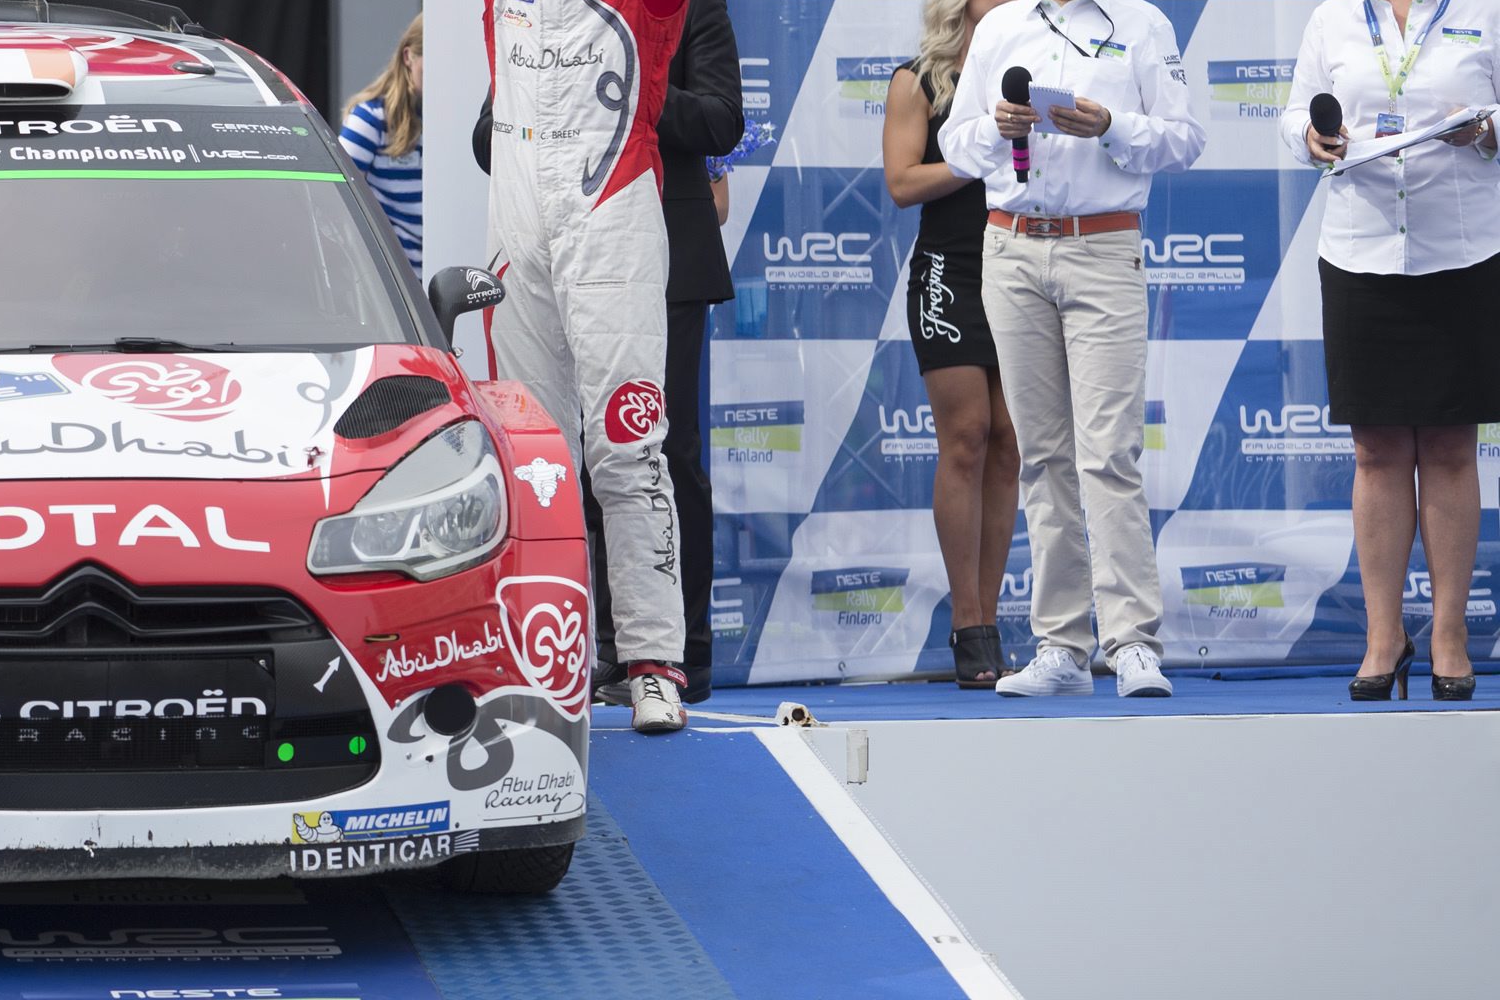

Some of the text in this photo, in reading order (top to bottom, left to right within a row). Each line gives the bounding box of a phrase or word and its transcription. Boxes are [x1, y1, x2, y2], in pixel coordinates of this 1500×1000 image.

[1236, 65, 1292, 78] NESTE
[211, 123, 292, 132] CERTINA
[540, 129, 581, 140] C. BREEN
[9, 145, 187, 163] Championship
[764, 232, 872, 261] WRC
[725, 409, 778, 422] NESTE
[728, 448, 773, 463] Finland
[836, 572, 881, 585] NESTE
[1206, 567, 1257, 580] NESTE
[838, 609, 881, 626] Finland
[1208, 604, 1257, 619] Finland
[500, 770, 576, 794] Abu Dhabi
[484, 789, 570, 816] Racing
[344, 806, 448, 832] MICHELIN
[290, 834, 451, 872] IDENTICAR
[110, 987, 282, 999] NESTE
